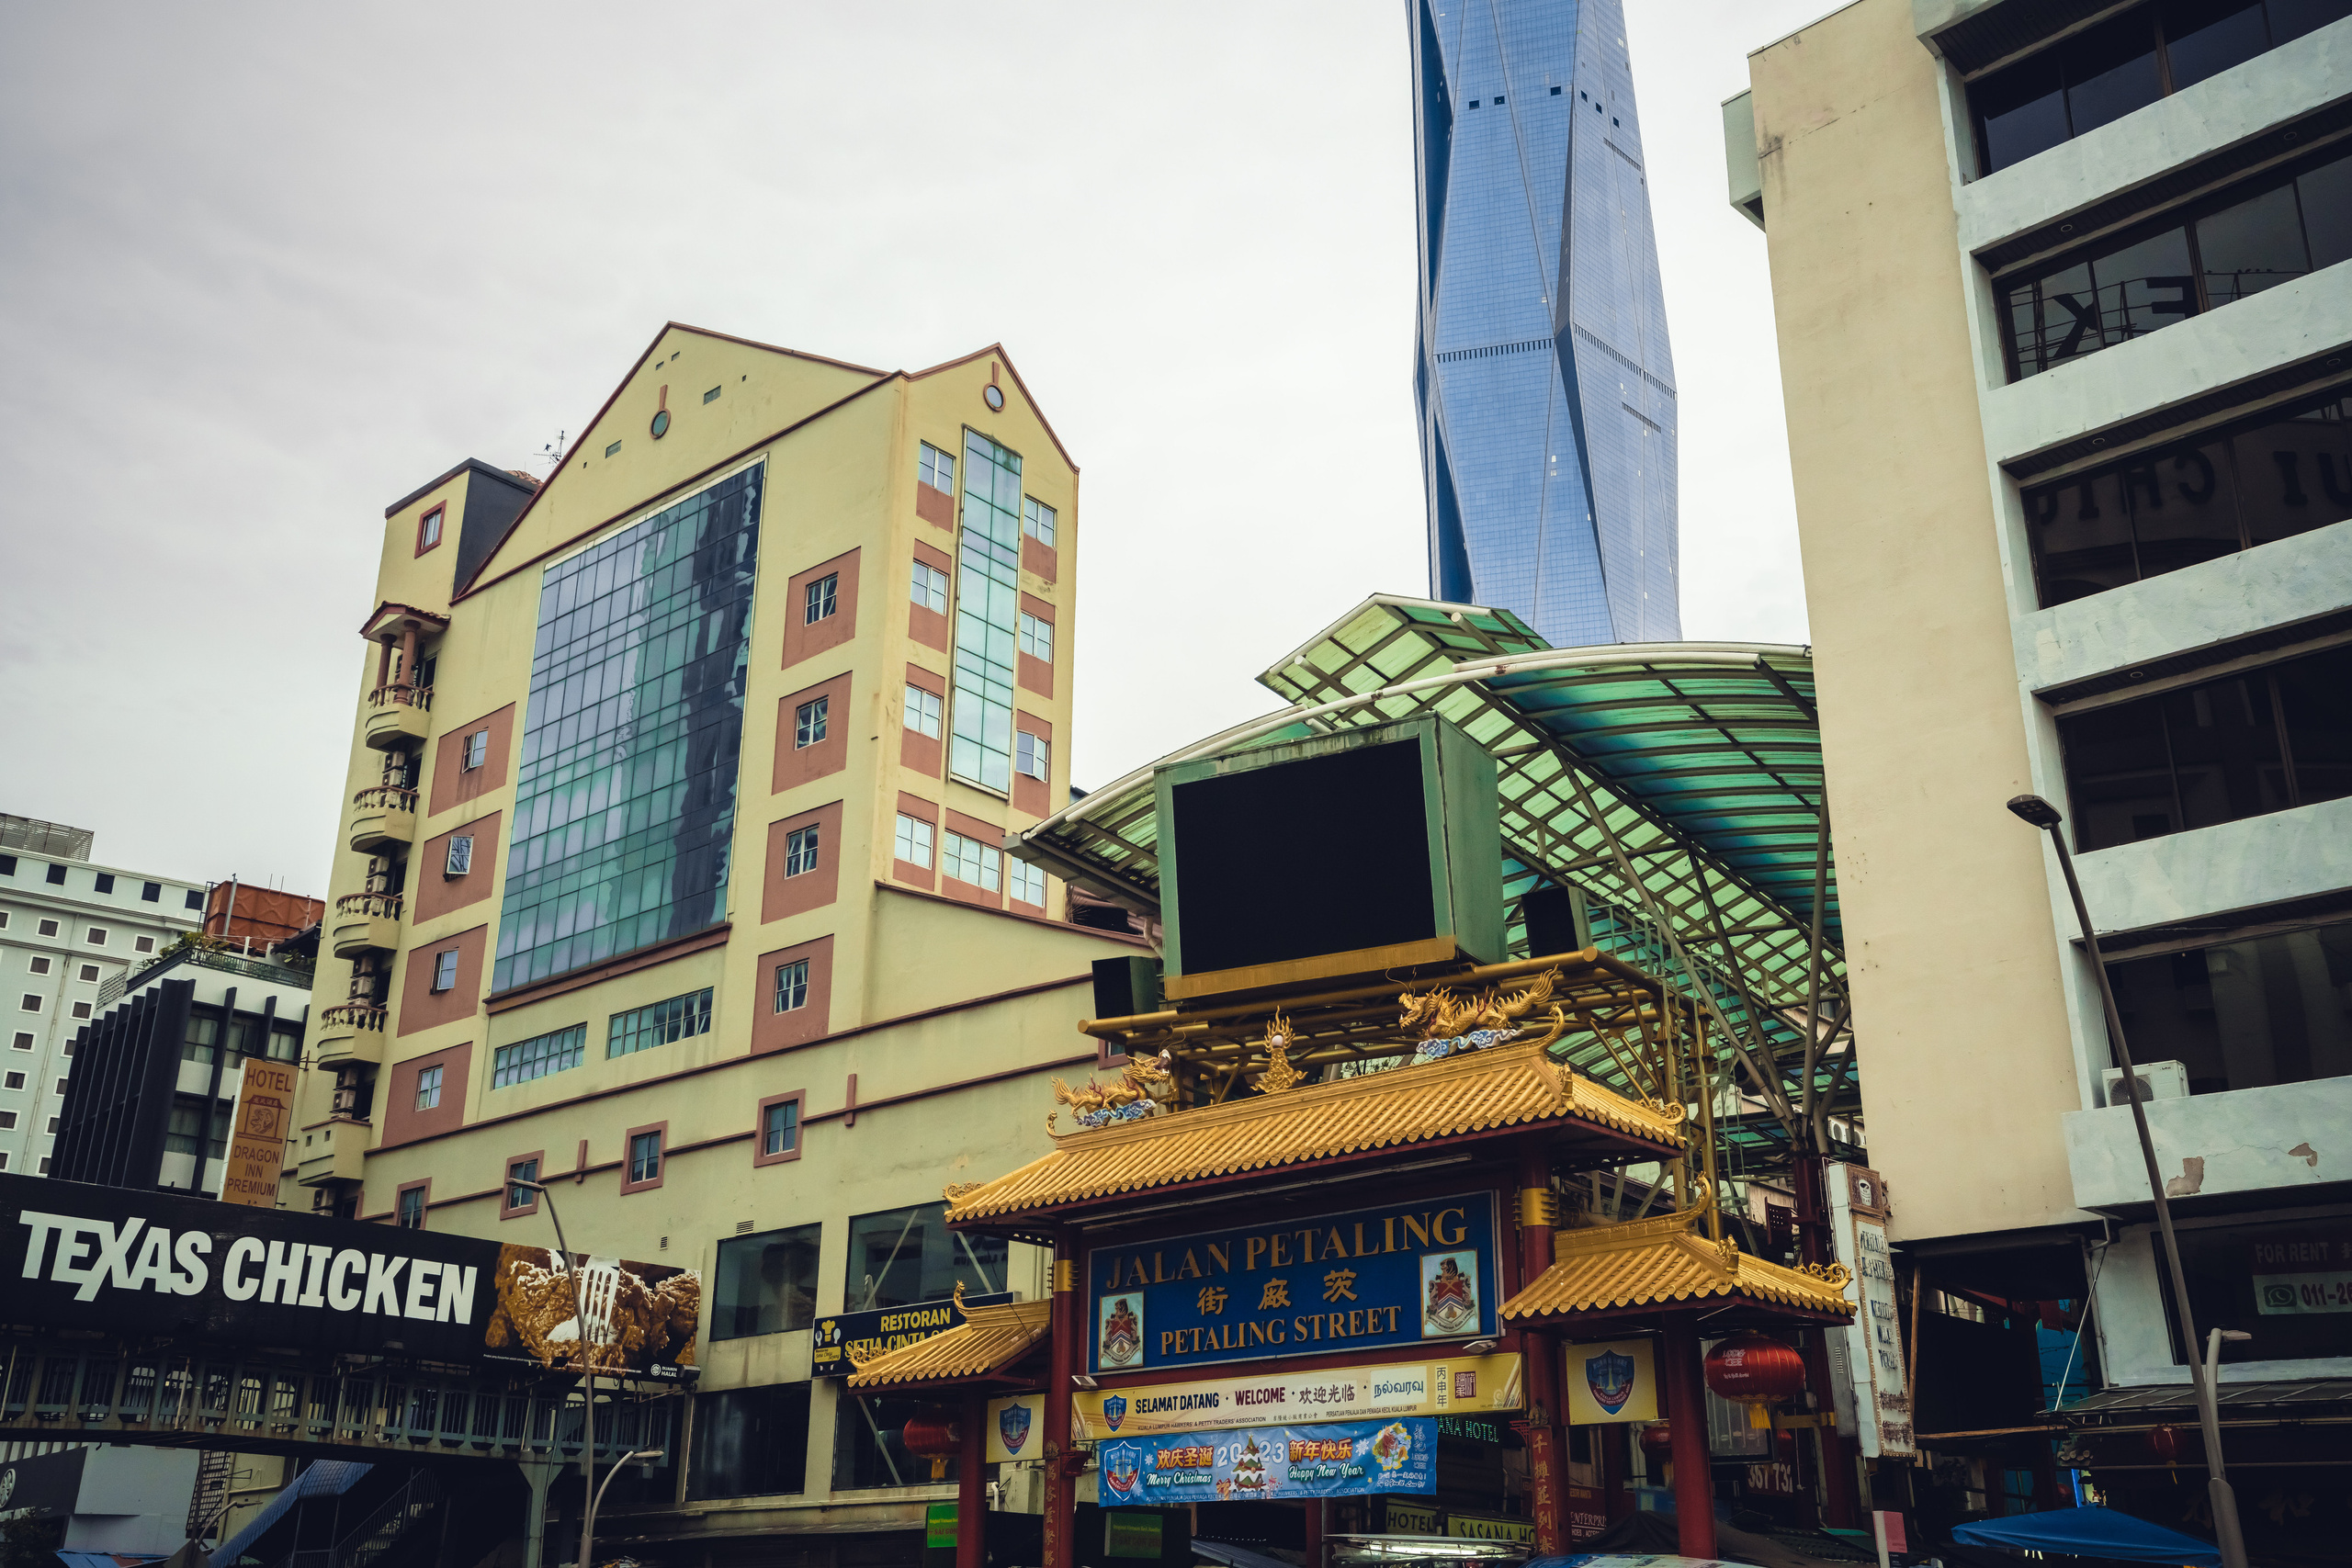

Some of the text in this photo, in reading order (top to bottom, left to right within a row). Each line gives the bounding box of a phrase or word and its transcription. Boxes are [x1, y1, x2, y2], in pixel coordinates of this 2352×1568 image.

[245, 1067, 291, 1092] HOTEL
[233, 1145, 280, 1164] DRAGON
[244, 1163, 264, 1179] INN
[226, 1178, 276, 1197] PREMIUM
[1106, 1206, 1468, 1290] JALAN PETALING
[2255, 1243, 2286, 1264] FOR
[2289, 1242, 2329, 1262] RENT
[18, 1210, 478, 1325] TEXAS CHICKEN
[880, 1308, 951, 1332] RESTORAN
[1160, 1317, 1286, 1356] PETALING
[1294, 1305, 1402, 1342] STREET
[1298, 1383, 1355, 1404] 欢迎光临
[1374, 1380, 1424, 1399] நல்வரவு
[1436, 1367, 1447, 1407] 丙申年
[1136, 1395, 1178, 1414] SELAMAT
[1180, 1393, 1219, 1411] DATANG
[1235, 1387, 1285, 1406] WELCOME
[1437, 1416, 1498, 1443] ANA HOTEL
[1156, 1446, 1214, 1470] 欢庆圣诞
[1288, 1438, 1353, 1462] 新年快乐
[1146, 1471, 1213, 1487] Merry Christmas
[1288, 1464, 1315, 1482] Happy
[1316, 1463, 1337, 1477] New
[1339, 1462, 1365, 1479] Year
[1387, 1511, 1433, 1532] HOTEL
[1460, 1521, 1512, 1540] SASANA
